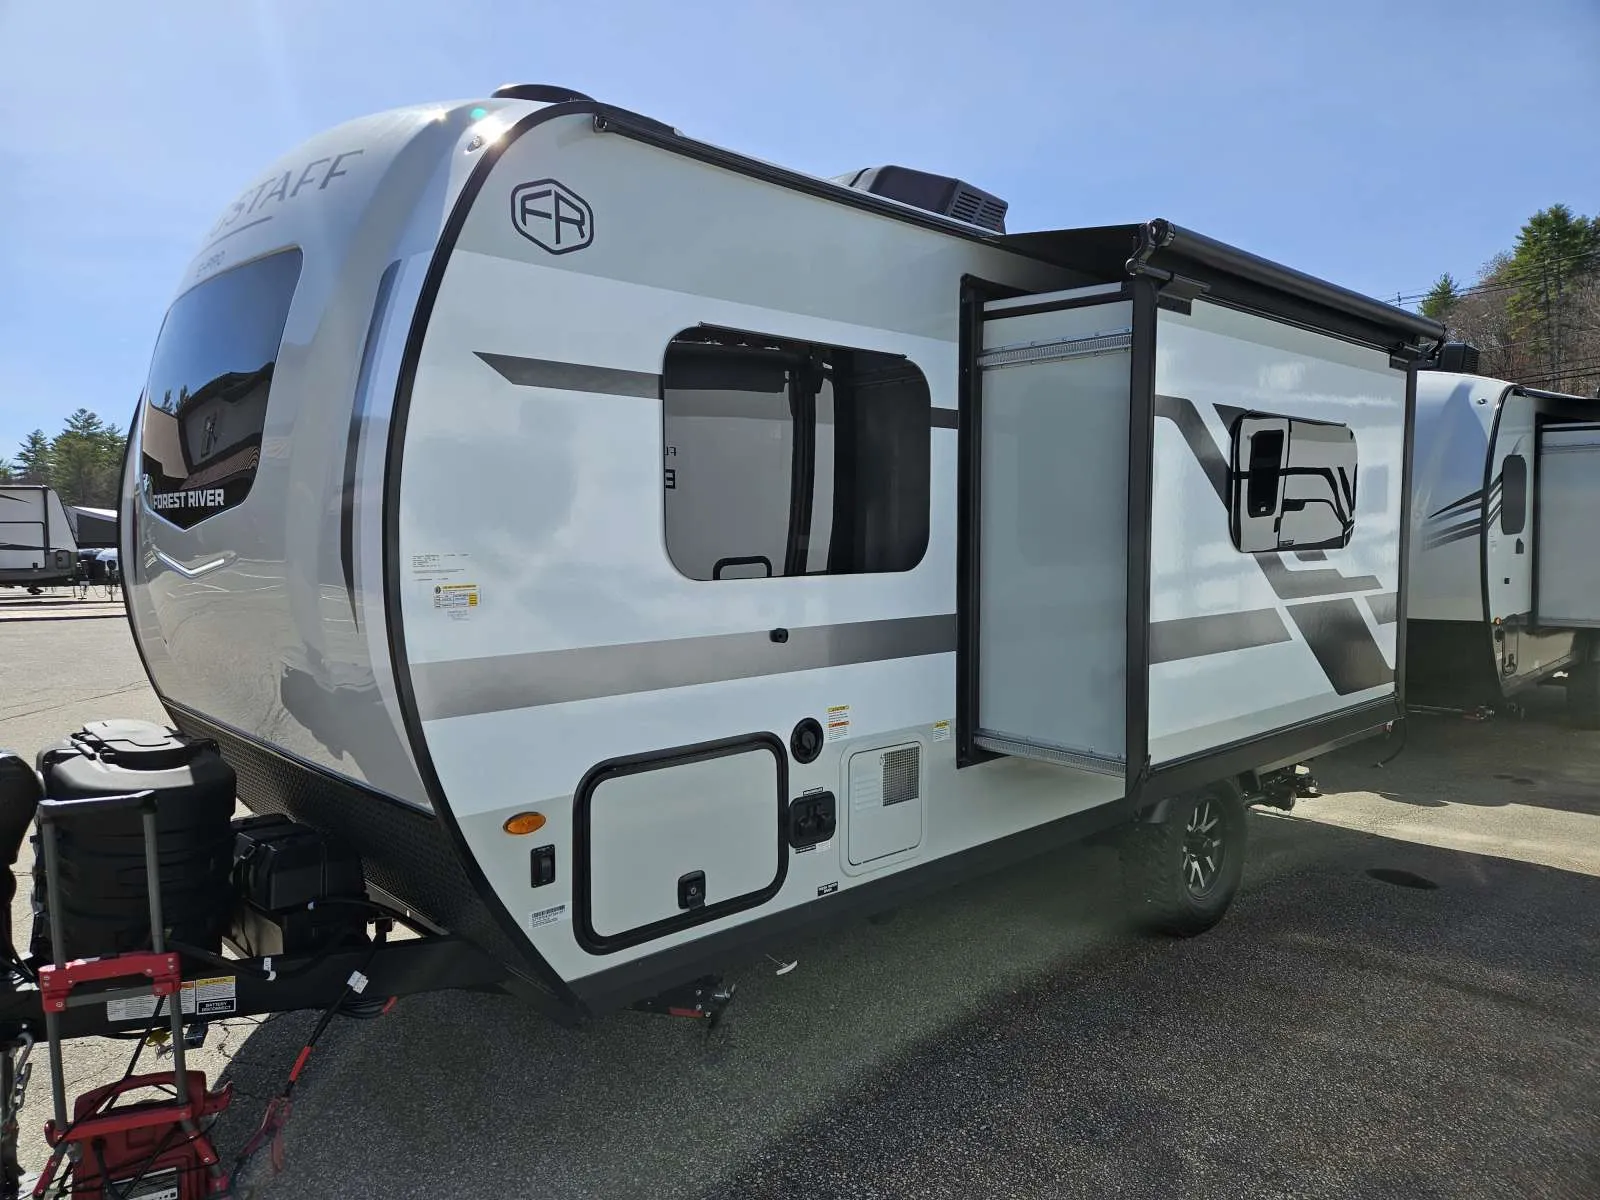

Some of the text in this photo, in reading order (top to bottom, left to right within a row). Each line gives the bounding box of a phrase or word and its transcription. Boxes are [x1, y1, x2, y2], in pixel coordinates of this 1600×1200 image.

[210, 149, 364, 238] STAFF
[519, 187, 587, 246] FR
[153, 489, 224, 509] FOREST RIVER
